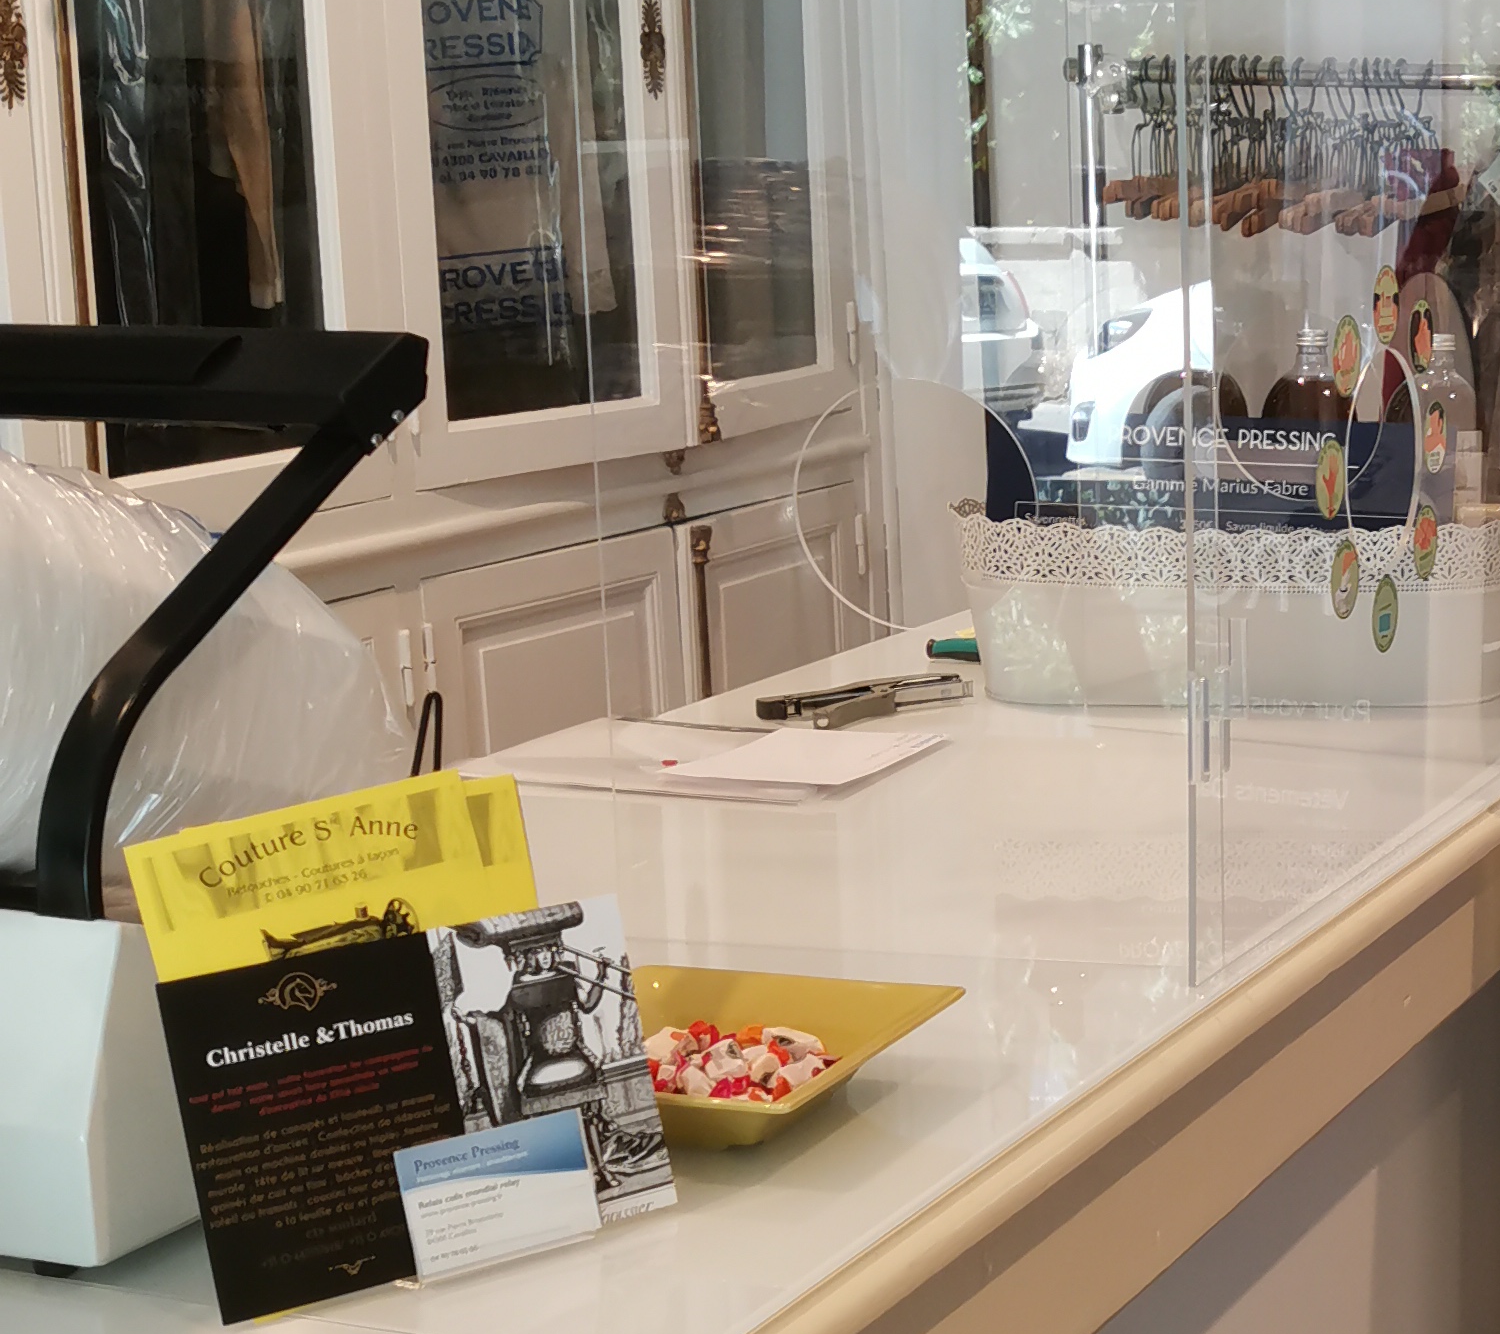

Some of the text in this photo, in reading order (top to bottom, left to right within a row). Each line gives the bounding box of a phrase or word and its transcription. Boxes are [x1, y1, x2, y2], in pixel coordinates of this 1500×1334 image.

[1203, 478, 1258, 495] Marius
[1263, 479, 1309, 497] Fabre
[199, 829, 307, 888] Couture
[350, 816, 419, 840] Anne
[206, 1033, 311, 1068] Christelle
